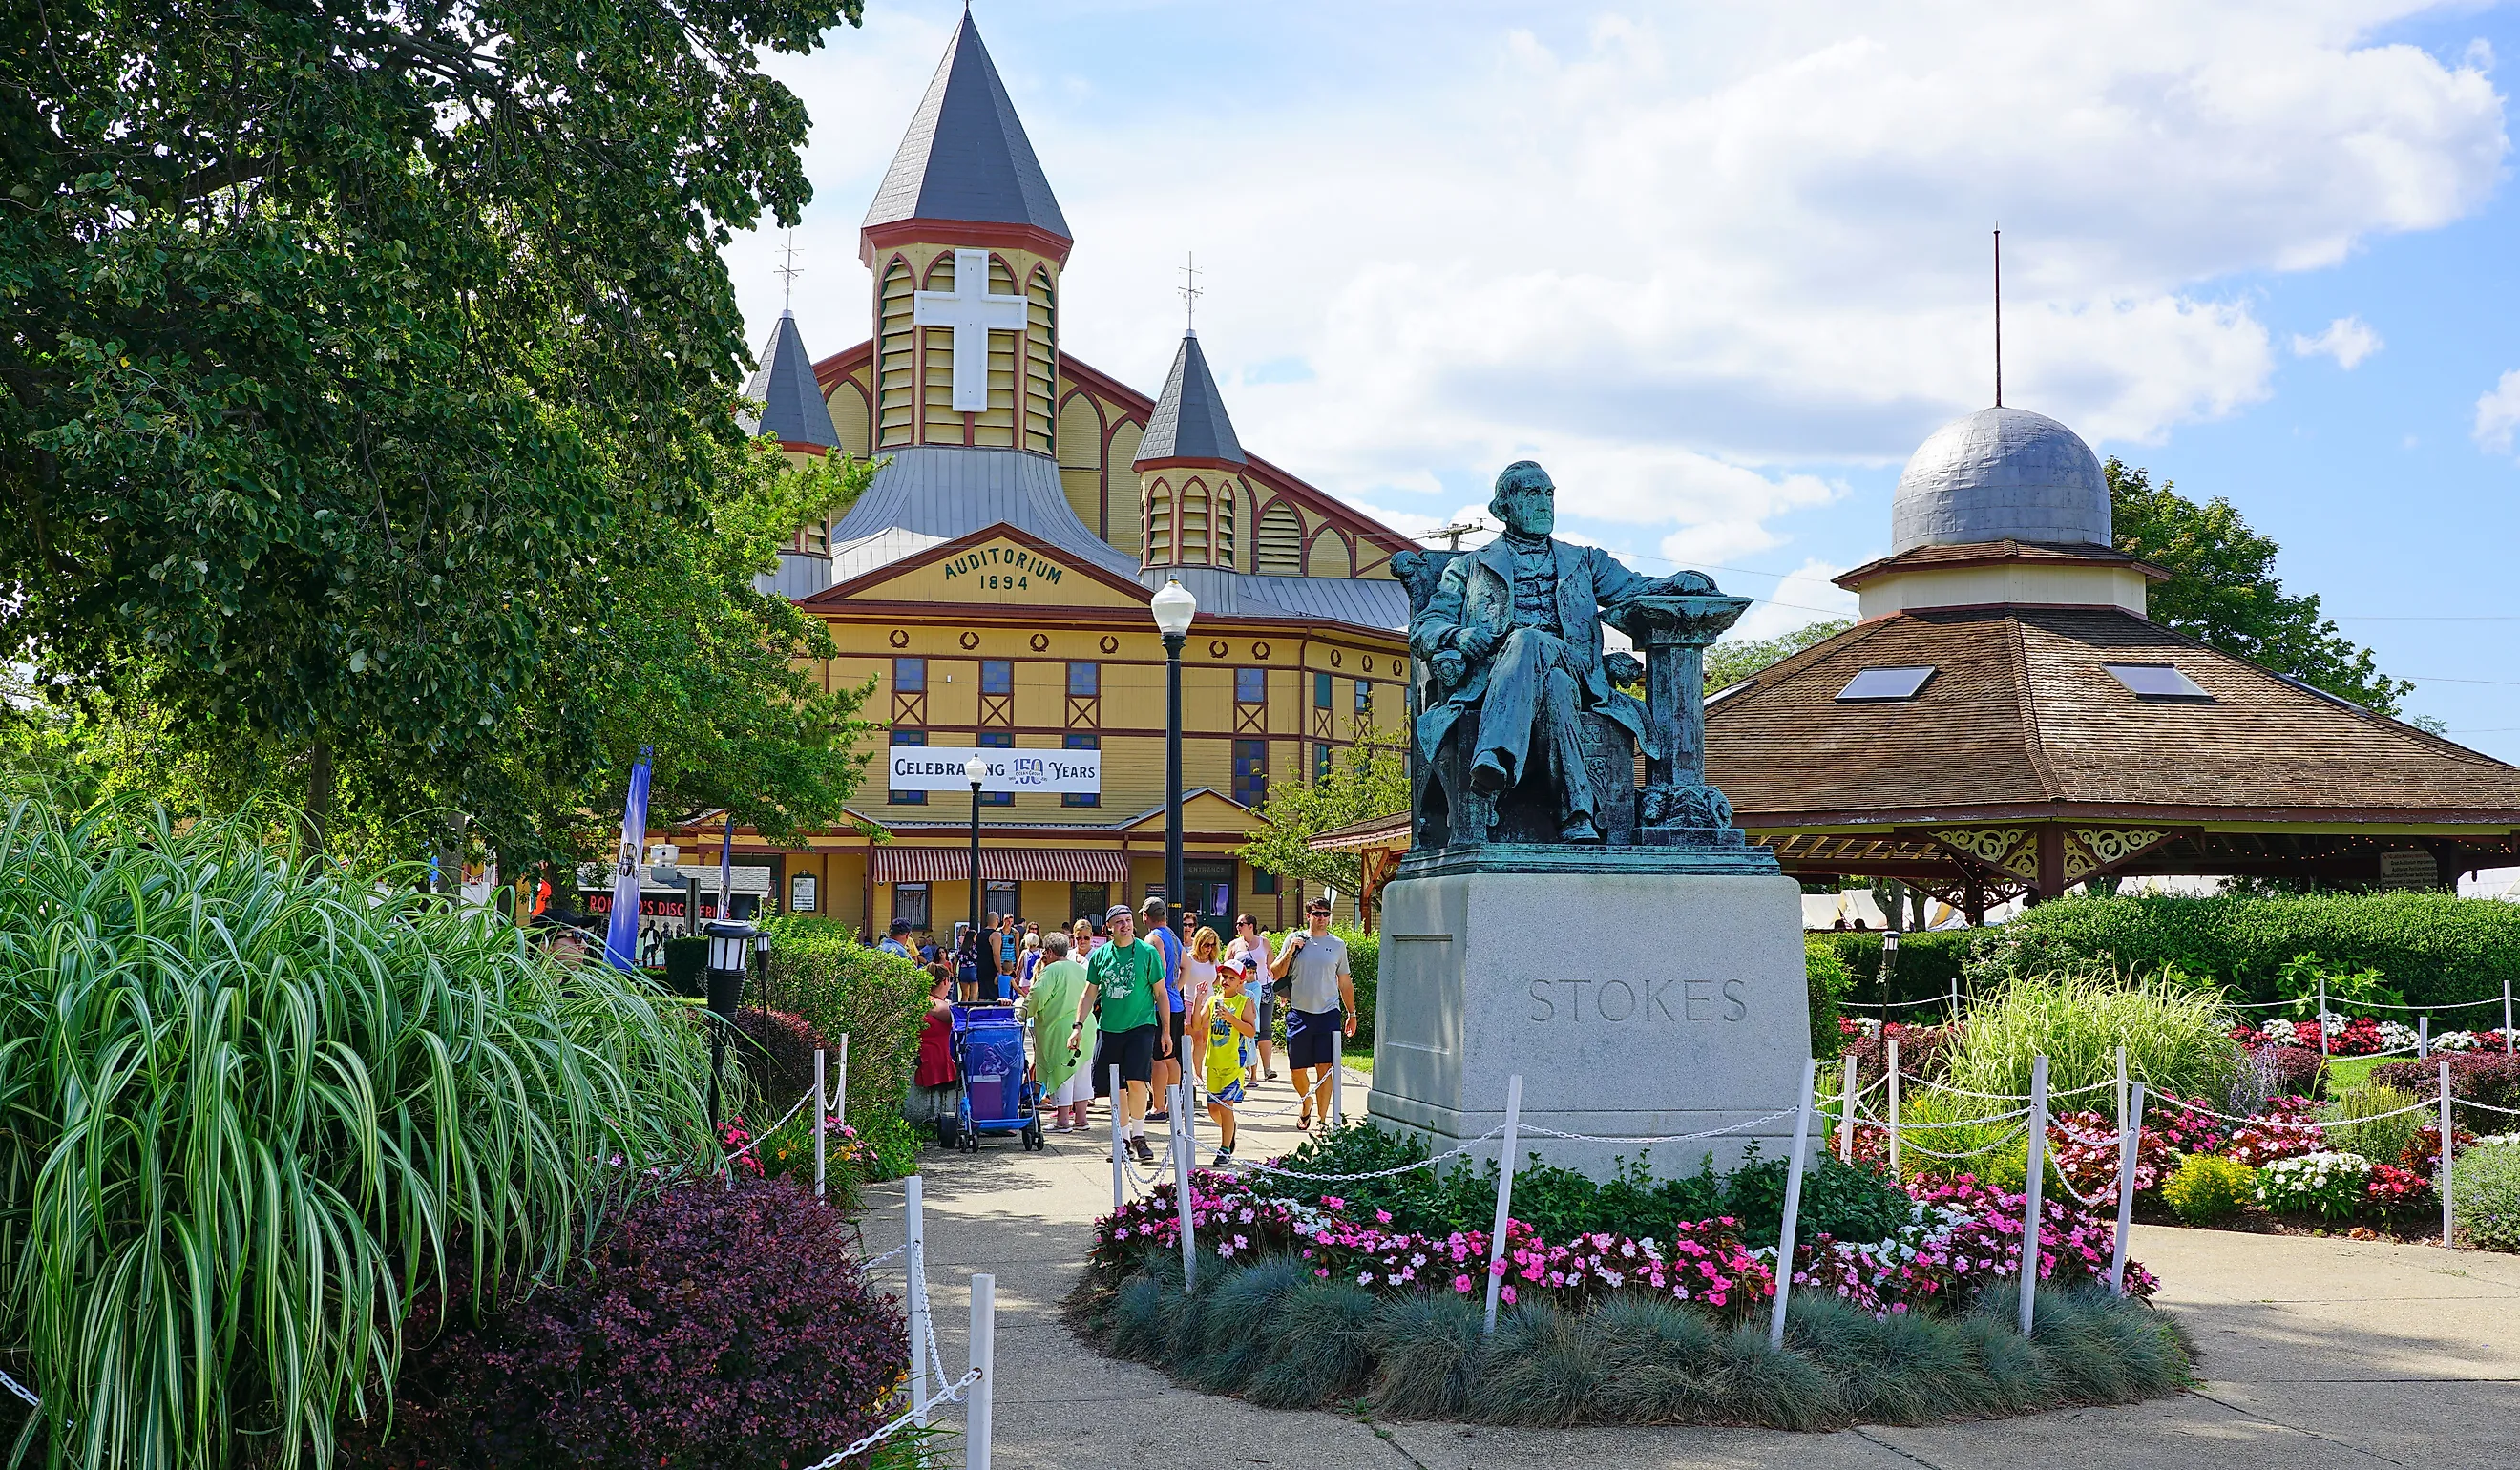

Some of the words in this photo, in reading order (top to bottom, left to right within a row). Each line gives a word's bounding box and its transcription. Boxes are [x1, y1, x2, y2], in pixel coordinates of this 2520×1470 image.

[945, 548, 1062, 585] AUDITORIUM
[980, 575, 1028, 591] 1894
[894, 758, 1005, 776] CELEBRANG
[1013, 758, 1044, 785] 150
[1048, 762, 1096, 781] YEARS
[658, 901, 687, 917] DISC
[699, 905, 731, 919] FRIS
[1529, 979, 1747, 1022] STOKES
